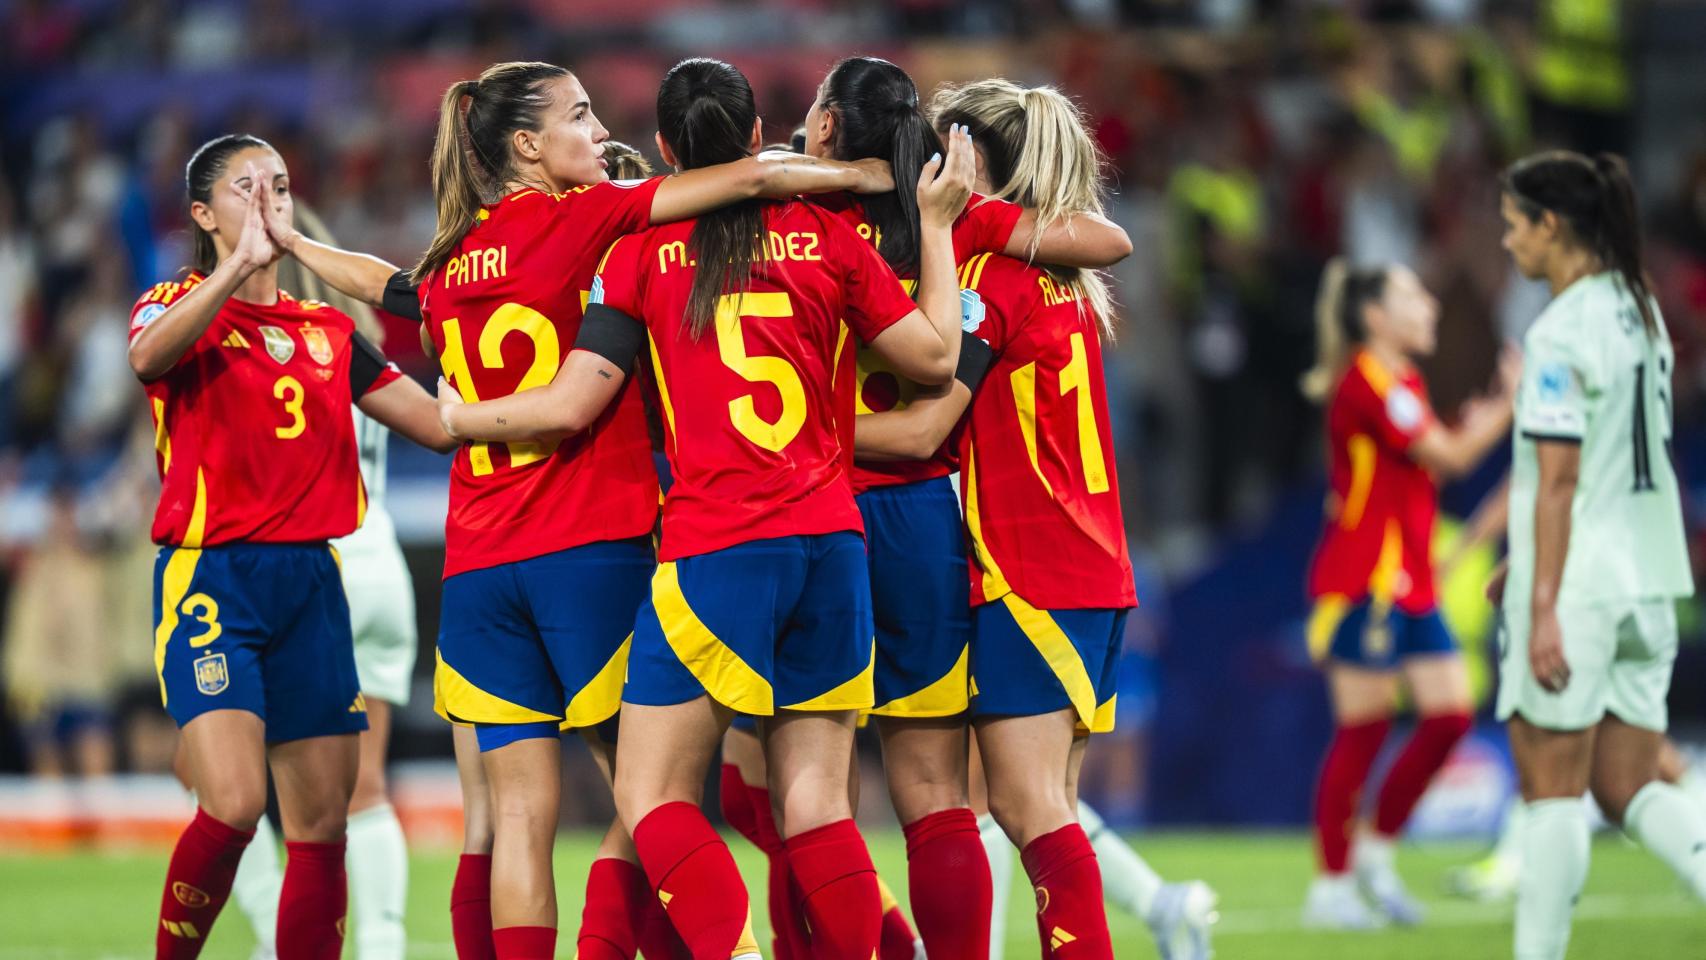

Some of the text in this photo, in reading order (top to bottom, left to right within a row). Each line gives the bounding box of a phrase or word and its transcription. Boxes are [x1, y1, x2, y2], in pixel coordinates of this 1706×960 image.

[445, 245, 507, 289] PATRI
[658, 239, 697, 275] M.
[439, 302, 561, 477] 12
[717, 291, 808, 453] 5
[273, 375, 307, 440] 3
[181, 592, 223, 649] 3
